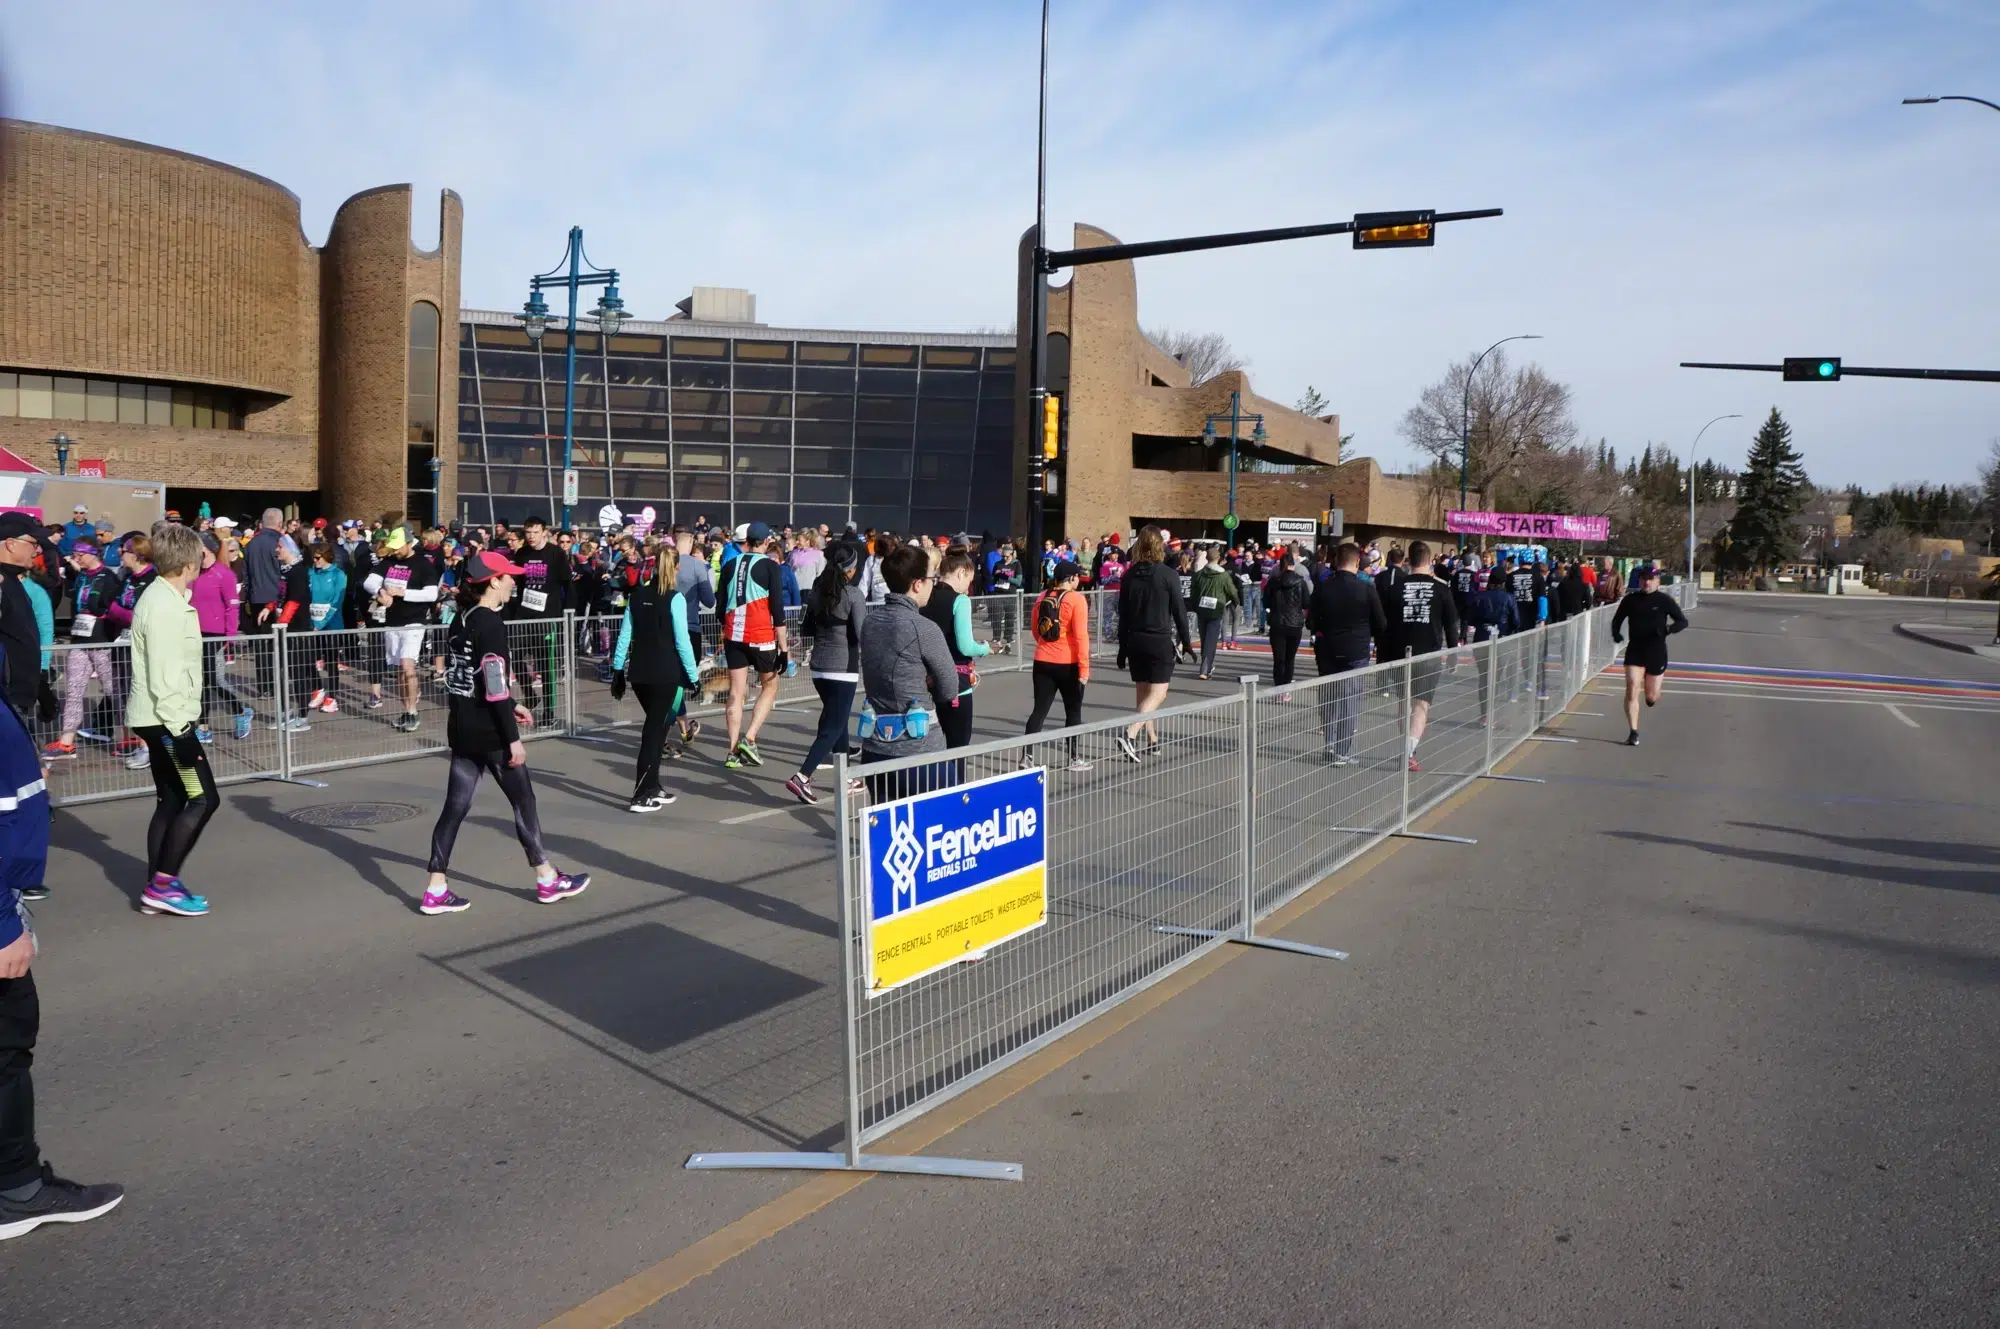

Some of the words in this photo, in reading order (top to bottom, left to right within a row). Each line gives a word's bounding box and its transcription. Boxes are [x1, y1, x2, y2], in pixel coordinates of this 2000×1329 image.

[106, 446, 194, 466] ALBERT
[211, 451, 271, 470] PLACE
[1280, 521, 1313, 530] museum
[1496, 516, 1557, 534] START
[926, 804, 1037, 869] FenceLine
[927, 861, 961, 883] RENTALS
[962, 856, 978, 872] LTD.
[876, 945, 900, 964] FENCE
[901, 933, 932, 954] RENTALS
[936, 918, 969, 940] PORTABLE
[970, 909, 994, 928] TOILETS
[997, 899, 1016, 916] WASTE
[1017, 890, 1042, 908] DISPOSAL
